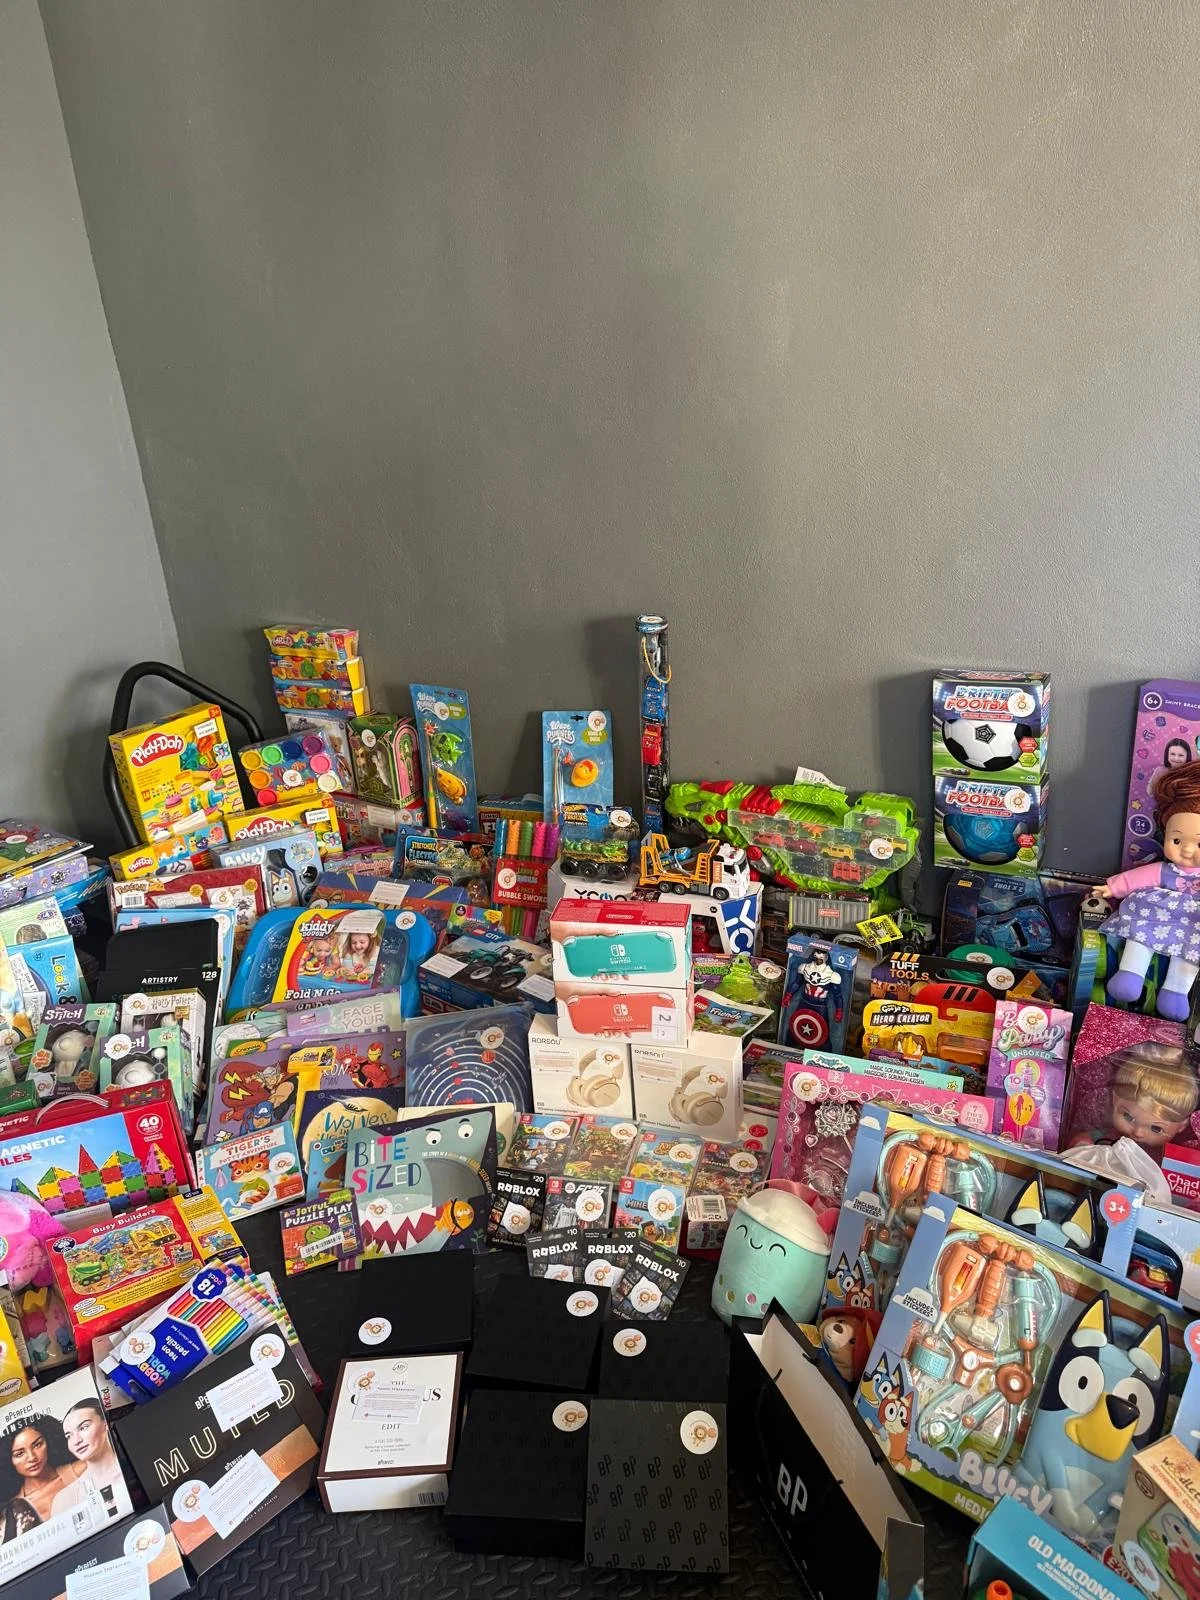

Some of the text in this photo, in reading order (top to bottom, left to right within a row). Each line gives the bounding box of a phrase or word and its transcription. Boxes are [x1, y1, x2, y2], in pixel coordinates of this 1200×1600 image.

[956, 687, 1011, 699] DRIFTE
[945, 699, 1009, 711] FOOTBA
[1183, 702, 1200, 710] BRACE
[131, 735, 184, 765] Play-Doh
[958, 783, 1006, 796] DRIFTE
[946, 792, 1006, 807] FOOTBA
[498, 890, 522, 900] BUBBLE
[300, 920, 336, 935] Kiddy
[890, 961, 920, 971] TUFF
[141, 971, 218, 985] ARTISTRY 128
[889, 969, 930, 981] TOOLS
[285, 989, 311, 1000] Fold
[313, 989, 323, 999] N
[342, 1003, 383, 1019] FACE
[872, 1012, 932, 1024] HERO CREATOR
[342, 1013, 385, 1030] YOUR
[770, 1050, 802, 1061] Friend
[1011, 1049, 1051, 1060] UNBOXED
[0, 1116, 29, 1128] NETIC
[139, 1116, 160, 1128] 40
[0, 1135, 66, 1158] AGNETIC
[226, 1135, 272, 1156] TIGER'S
[0, 1152, 33, 1167] ILES
[1166, 1172, 1200, 1190] Chad
[497, 1182, 541, 1197] ROBLOX
[294, 1202, 329, 1217] JOYFUL
[854, 1198, 882, 1214] INCLUDES
[1108, 1201, 1126, 1215] 3+
[92, 1207, 157, 1236] Busy Builders
[285, 1202, 353, 1228] PUZZLE PLAY
[532, 1241, 578, 1259] ROBLOX
[587, 1244, 634, 1255] ROBLOX
[635, 1254, 680, 1283] ROBLOX
[197, 1280, 215, 1297] 18
[905, 1294, 934, 1312] INCLUDES
[161, 1344, 179, 1362] neon
[165, 1335, 190, 1357] pencils
[149, 1354, 171, 1379] WORL
[138, 1361, 167, 1388] HOBB
[0, 1406, 52, 1439] KINSTUDIO
[776, 1462, 808, 1516] BP
[0, 1535, 35, 1564] ORNING
[1027, 1534, 1054, 1560] OLD
